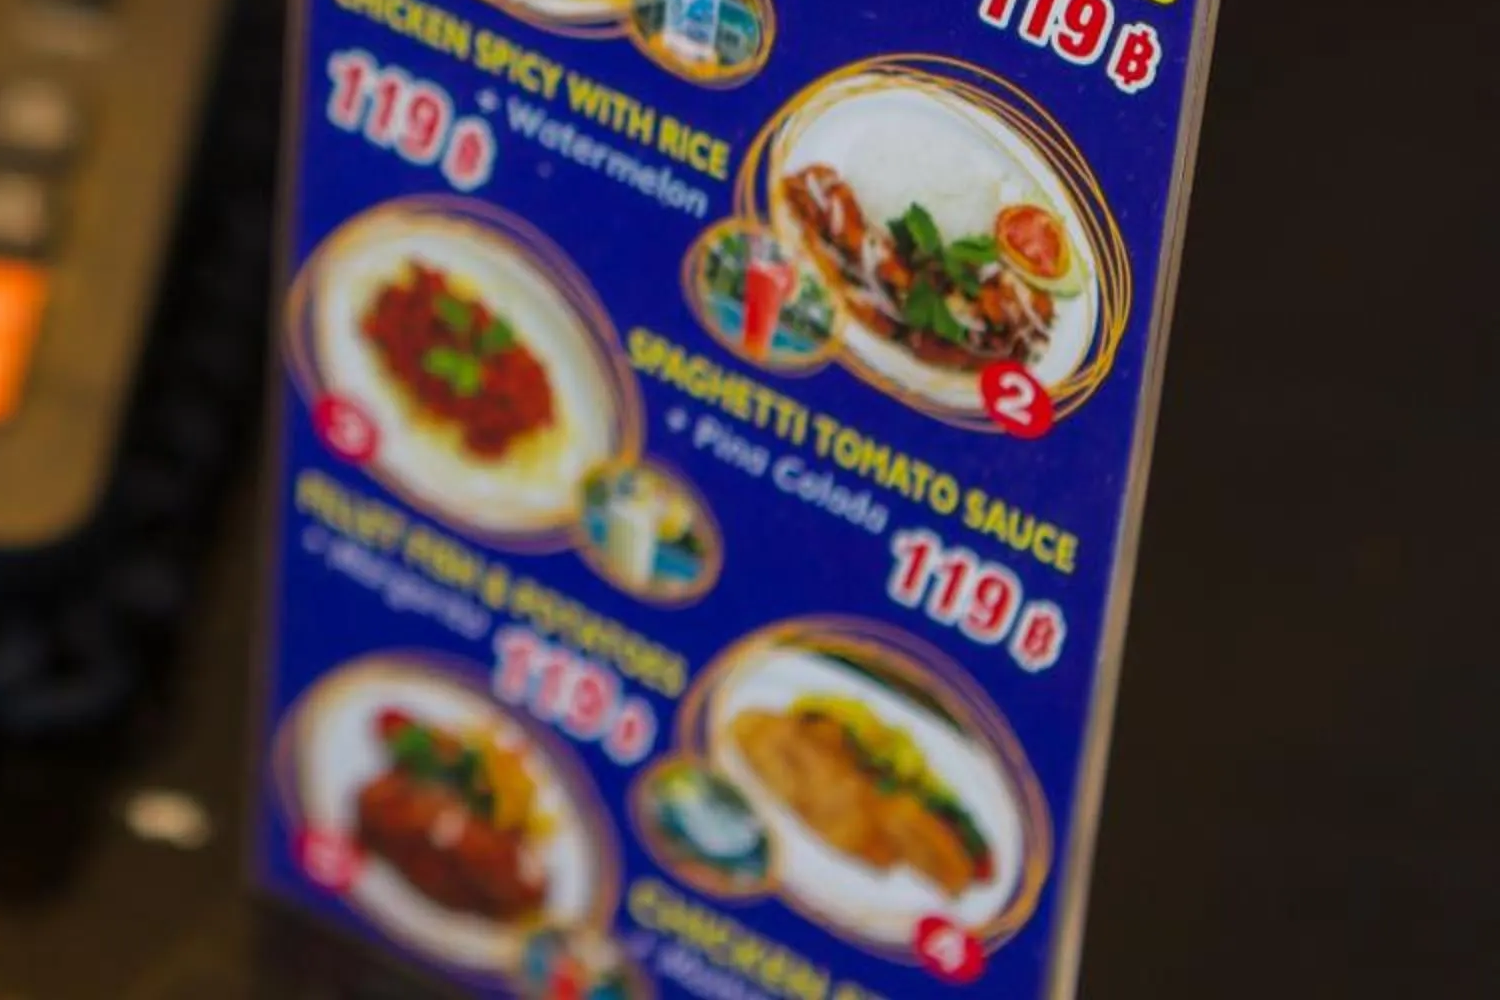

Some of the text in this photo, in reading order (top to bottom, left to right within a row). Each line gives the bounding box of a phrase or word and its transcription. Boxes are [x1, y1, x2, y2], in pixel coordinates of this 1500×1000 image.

[327, 49, 453, 166] 119
[474, 32, 563, 99] SPICY
[567, 72, 656, 144] WITH
[658, 112, 731, 181] RICE
[505, 97, 709, 219] Watermelon
[627, 327, 1079, 574] SPAGHETTI TOMATO SAUCE
[994, 371, 1036, 426] 2
[886, 527, 1024, 644] 119
[493, 625, 622, 741] 119
